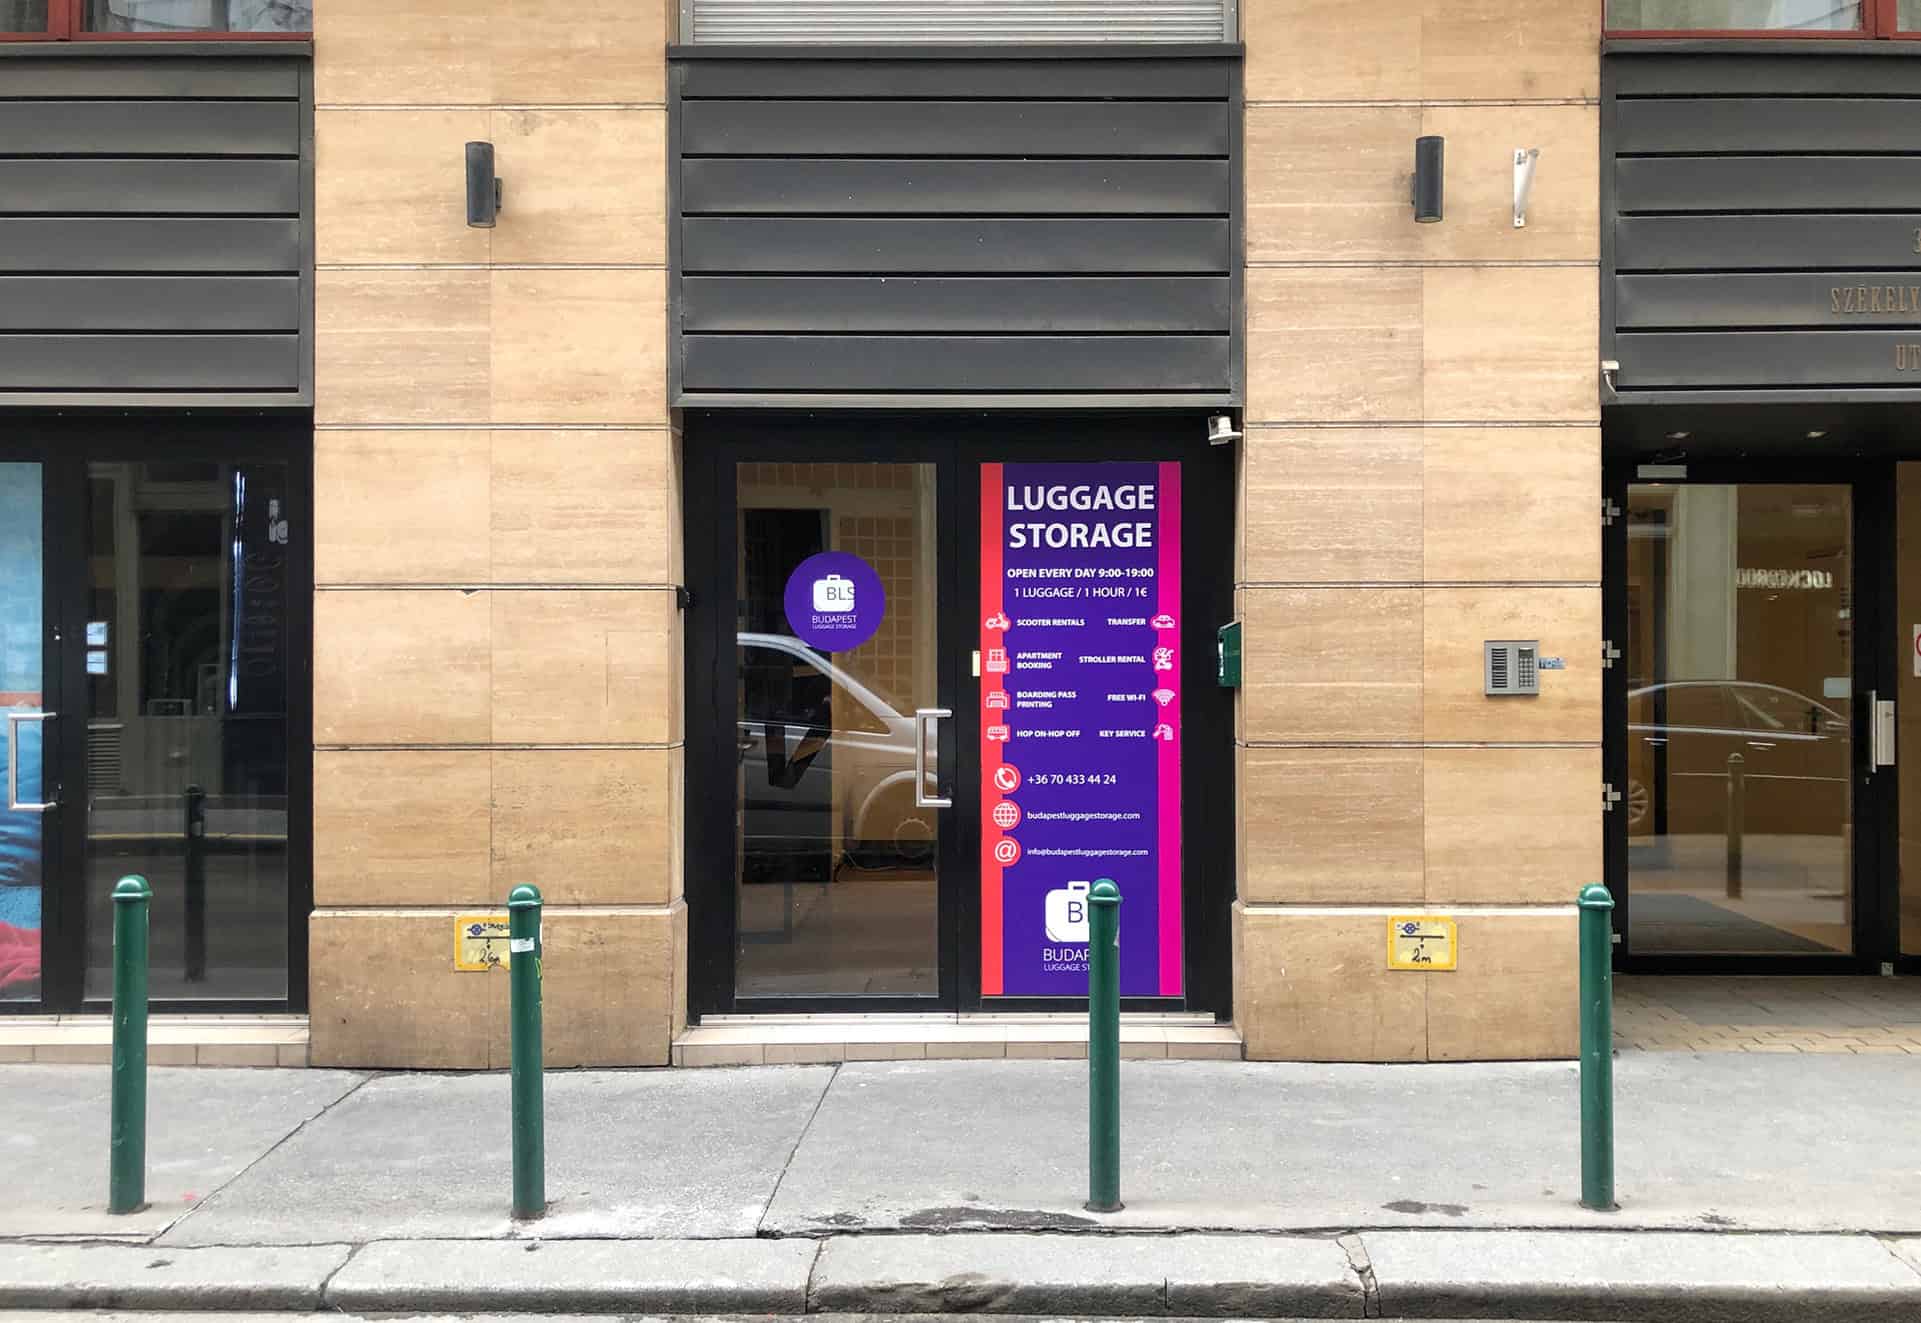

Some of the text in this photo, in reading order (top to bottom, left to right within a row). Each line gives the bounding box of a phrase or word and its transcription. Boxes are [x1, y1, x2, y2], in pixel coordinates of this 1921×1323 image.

[1007, 484, 1155, 511] LUGGAGE
[1009, 522, 1153, 549] STORAGE
[1007, 568, 1154, 579] OPEN EVERY DAY 9:00-19:00
[1014, 587, 1148, 599] 1 LUGGAGE / 1 HOUR / 1€
[812, 615, 857, 624] BUDAPEST
[1016, 618, 1086, 627] SCOOTER RENTALS
[1107, 618, 1147, 626] TRANSFER
[1016, 652, 1063, 660] APARTMENT
[1078, 655, 1146, 664] STROLLER RENTAL
[1016, 661, 1053, 670] BOOKING
[1016, 690, 1077, 699] BOARDING PASS
[1107, 694, 1146, 702] FREE WI-FI
[1016, 700, 1053, 709] PRINTING
[1016, 730, 1081, 738] HOP ON-HOP OFF
[1099, 730, 1146, 738] KEY SERVICE
[1027, 774, 1117, 785] +36 70 433 44 24
[1027, 811, 1141, 822] budapestluggagestorage.com
[1027, 847, 1149, 858] info@budapestluggagestorage.com
[1043, 948, 1090, 962] BUDAP
[1043, 963, 1081, 972] LUGGAGE
